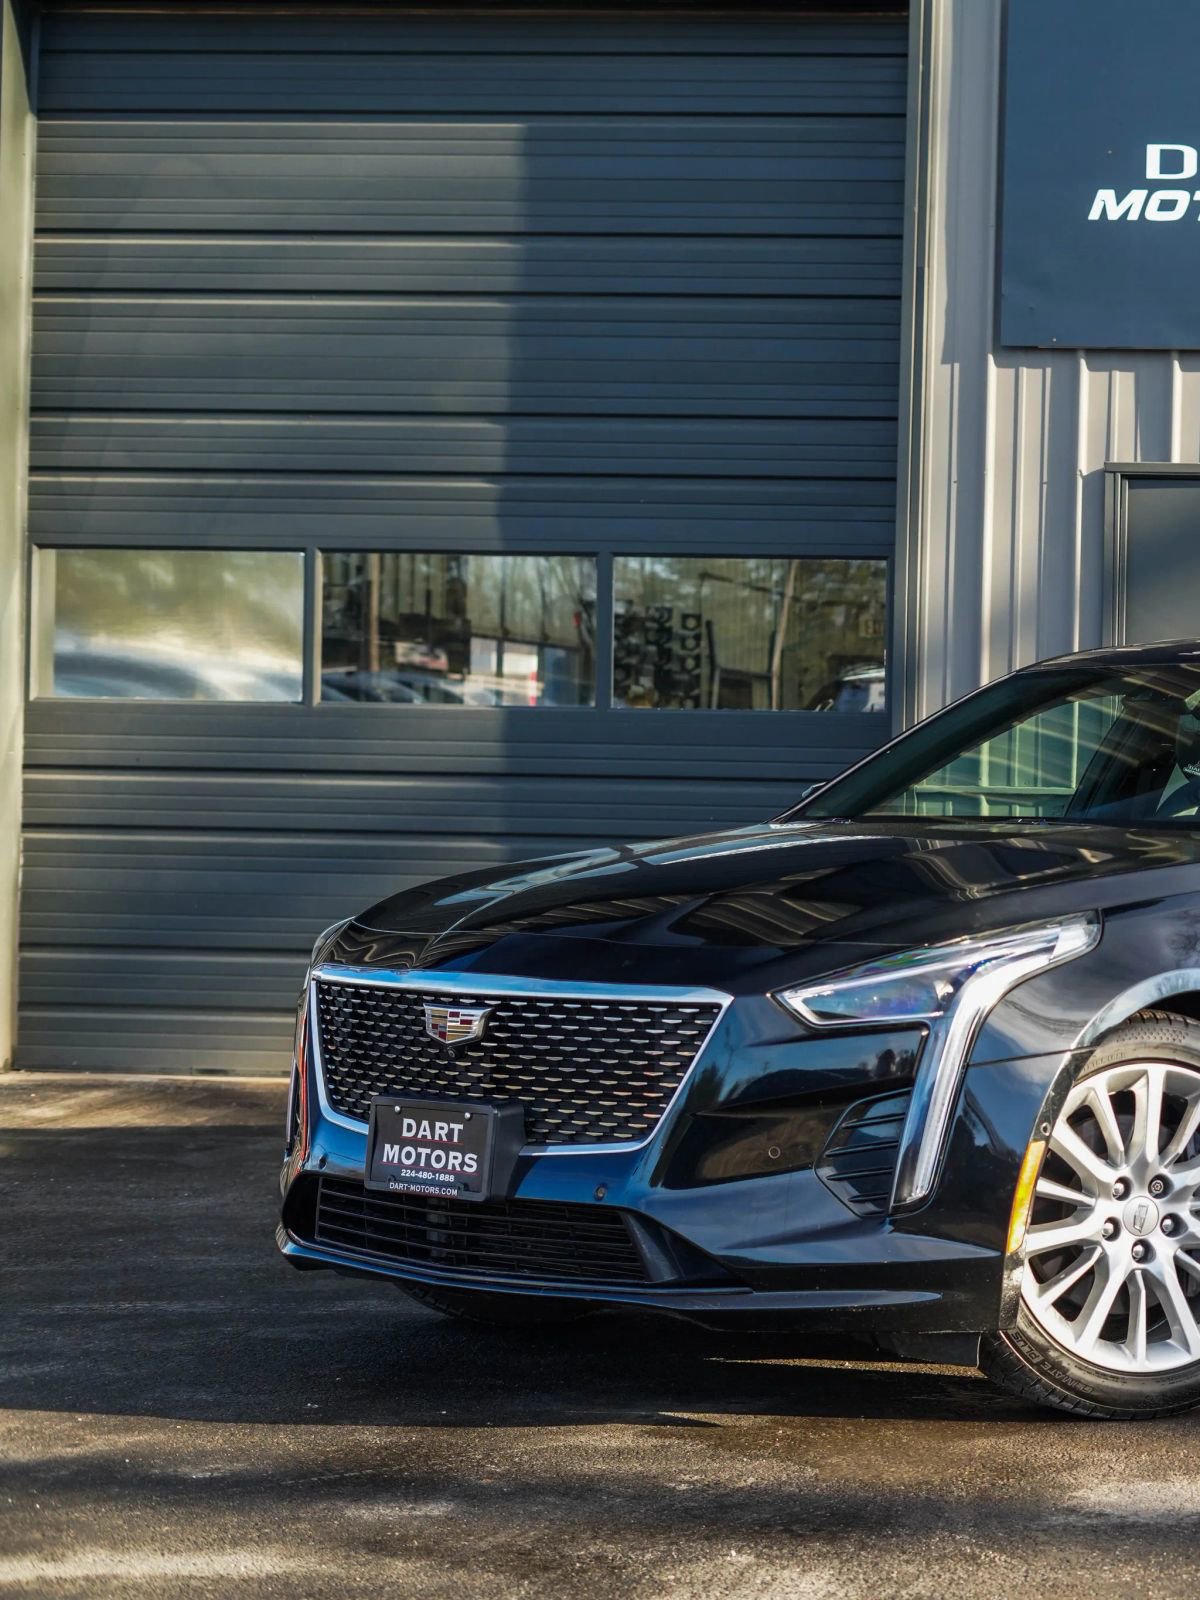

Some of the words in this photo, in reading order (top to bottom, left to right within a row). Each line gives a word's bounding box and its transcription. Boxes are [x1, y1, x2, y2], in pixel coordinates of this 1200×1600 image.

[402, 1118, 464, 1143] DART
[382, 1143, 478, 1173] MOTORS
[400, 1169, 455, 1182] 224-480-1888
[389, 1182, 458, 1196] DART-MOTORS.COM
[1011, 1332, 1040, 1360] PLUS
